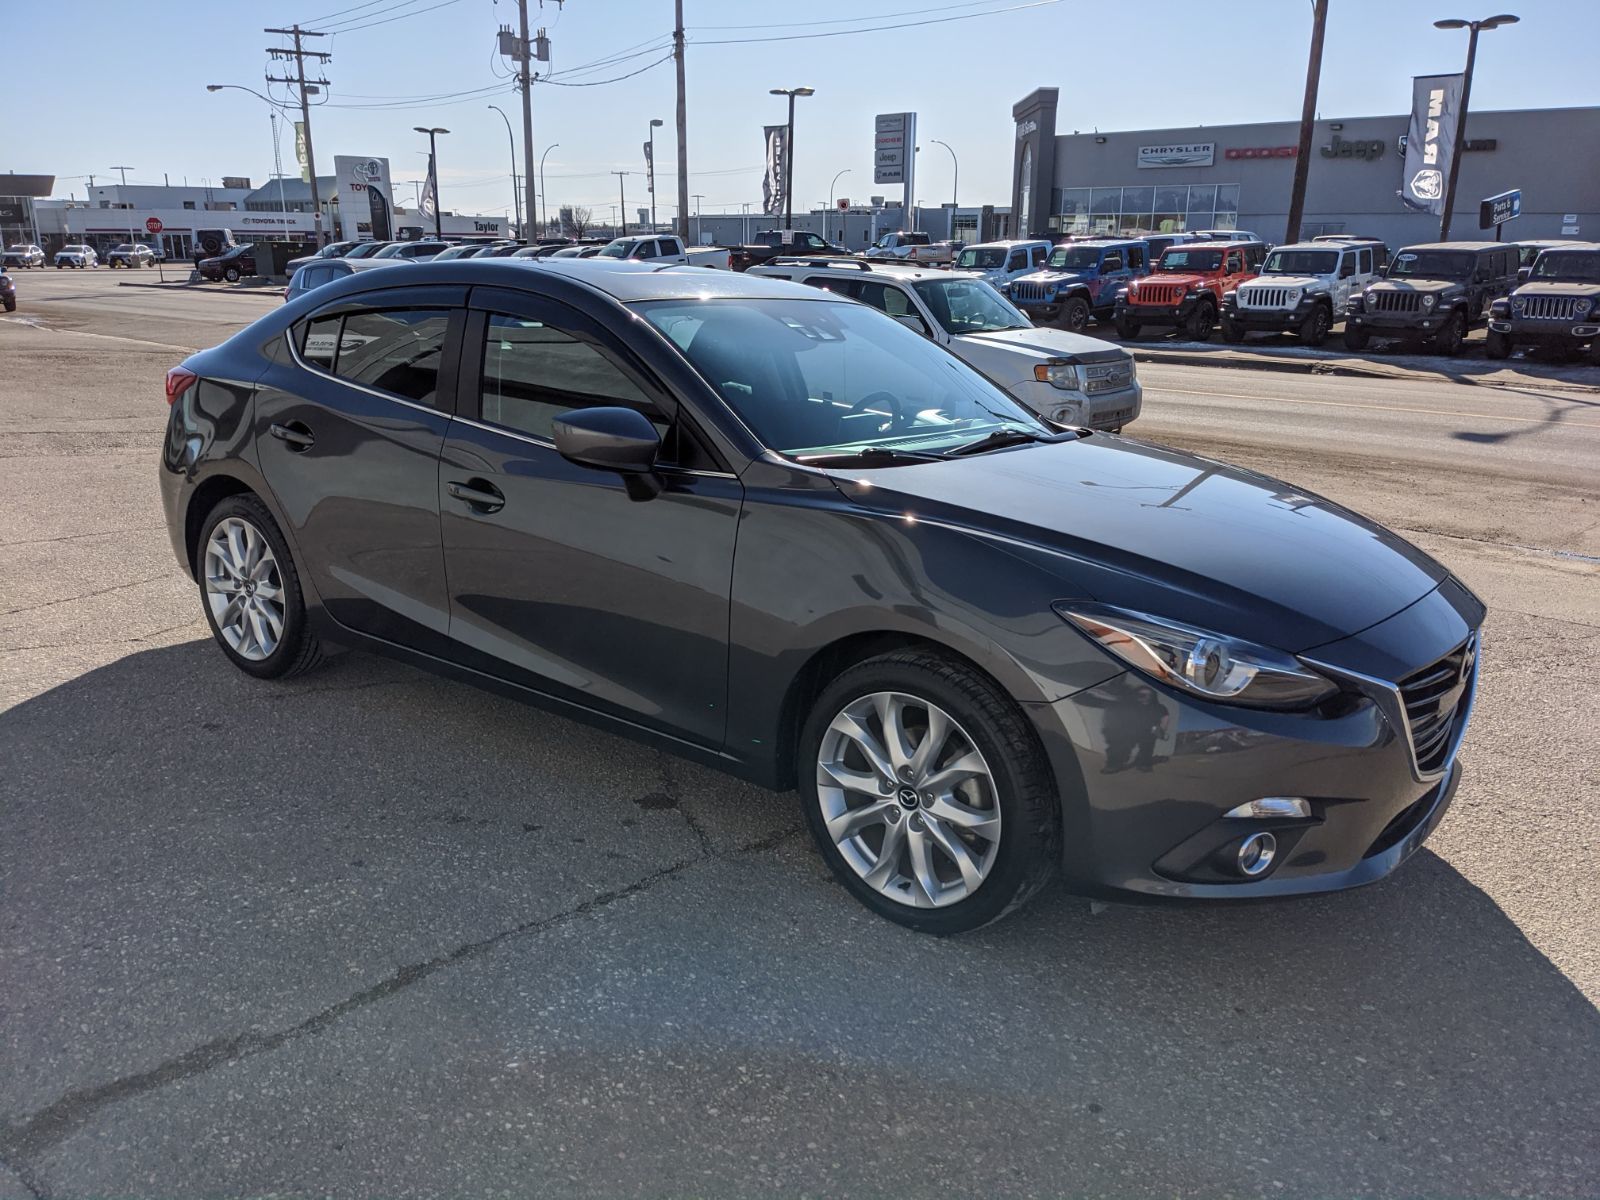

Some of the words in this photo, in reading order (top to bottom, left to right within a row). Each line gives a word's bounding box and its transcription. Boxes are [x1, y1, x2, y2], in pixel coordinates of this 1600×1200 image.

[1141, 145, 1211, 155] CHRYSLER
[1320, 135, 1385, 162] Jeep
[1493, 202, 1507, 213] Parts
[1493, 210, 1511, 223] Service
[146, 221, 162, 230] STOP
[474, 221, 499, 233] Taylor
